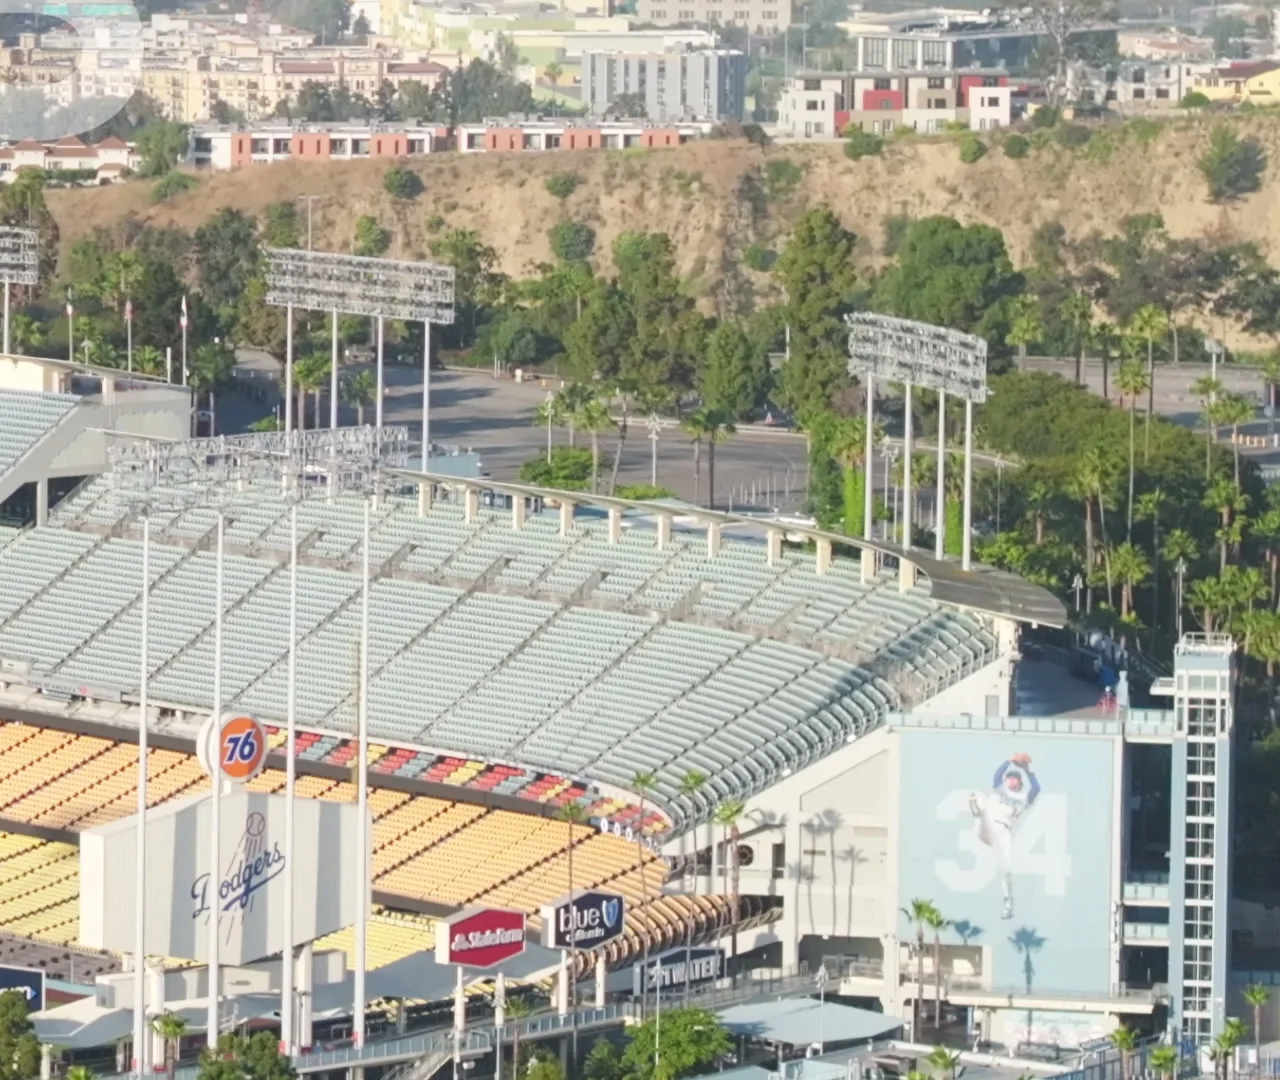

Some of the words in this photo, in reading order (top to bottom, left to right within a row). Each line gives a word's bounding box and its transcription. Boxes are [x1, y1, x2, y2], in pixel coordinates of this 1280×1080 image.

[224, 729, 257, 763] 76
[934, 789, 1073, 897] 34
[191, 842, 286, 918] Dodgers
[559, 904, 601, 933] blue
